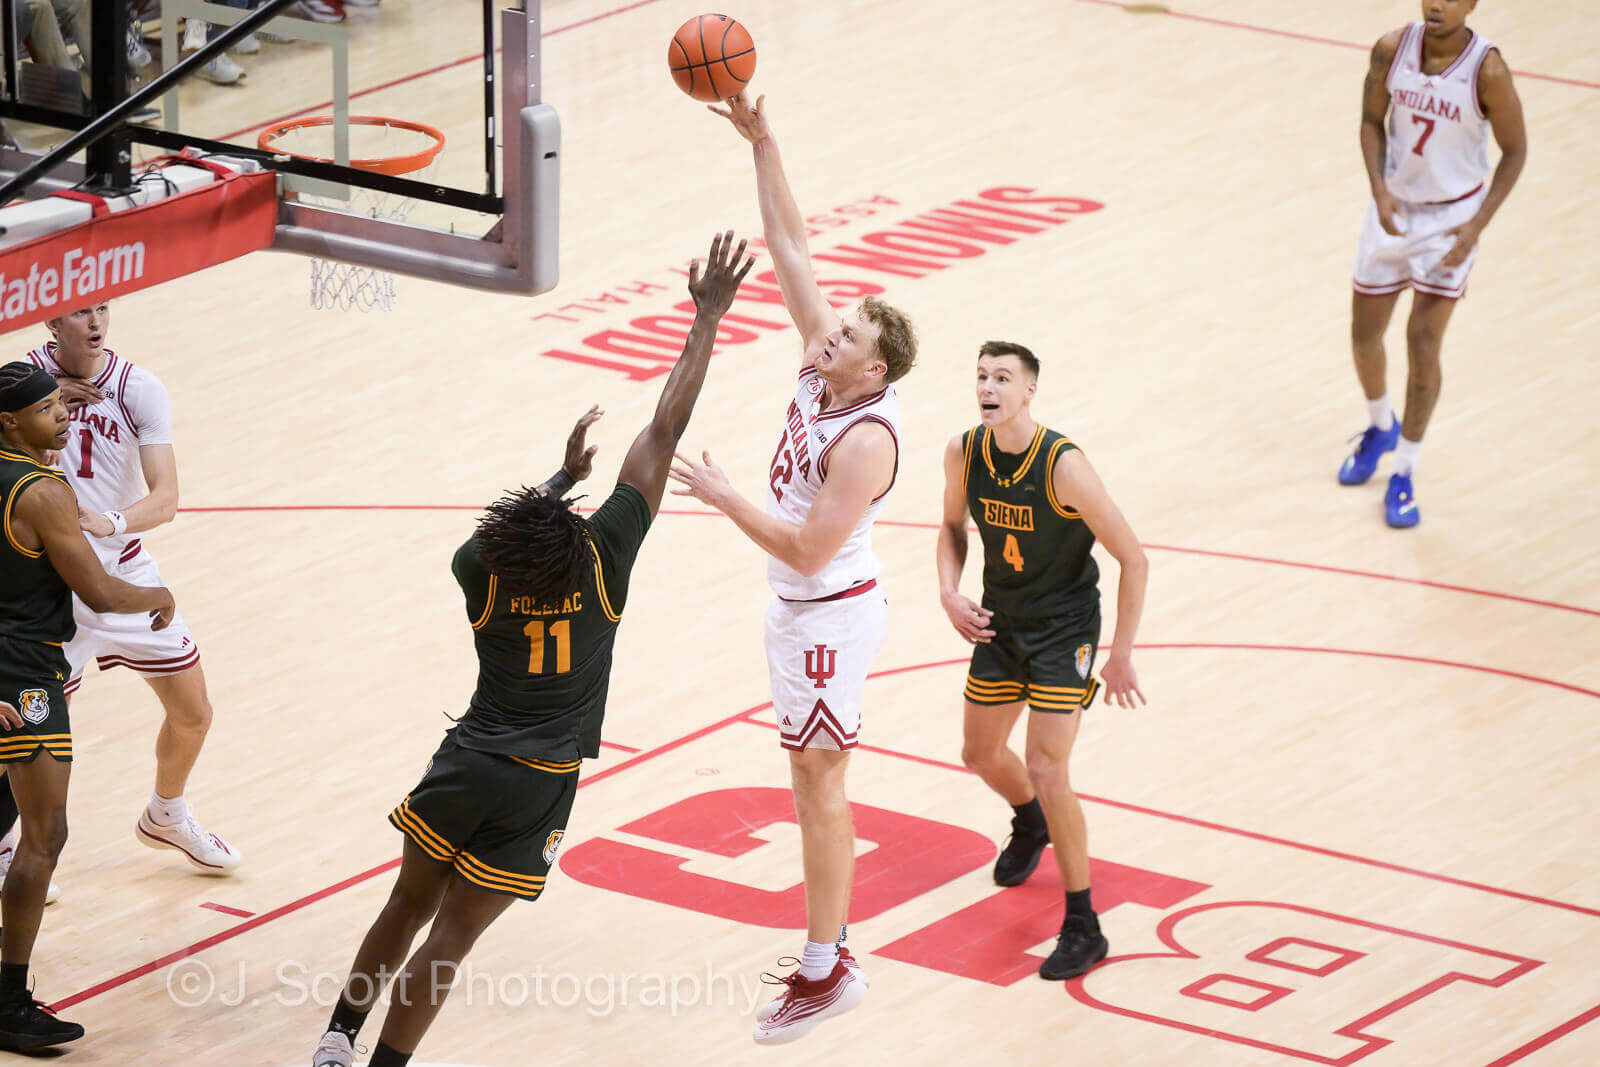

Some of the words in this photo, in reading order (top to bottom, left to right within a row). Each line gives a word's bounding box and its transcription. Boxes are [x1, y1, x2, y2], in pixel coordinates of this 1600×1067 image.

[1393, 88, 1461, 123] INDIANA
[1411, 113, 1435, 156] 7
[811, 186, 1107, 279] SIMON
[530, 280, 670, 323] HALL
[77, 429, 94, 479] 1
[985, 500, 1033, 530] SIENA
[1003, 533, 1024, 572] 4
[523, 619, 571, 674] 11
